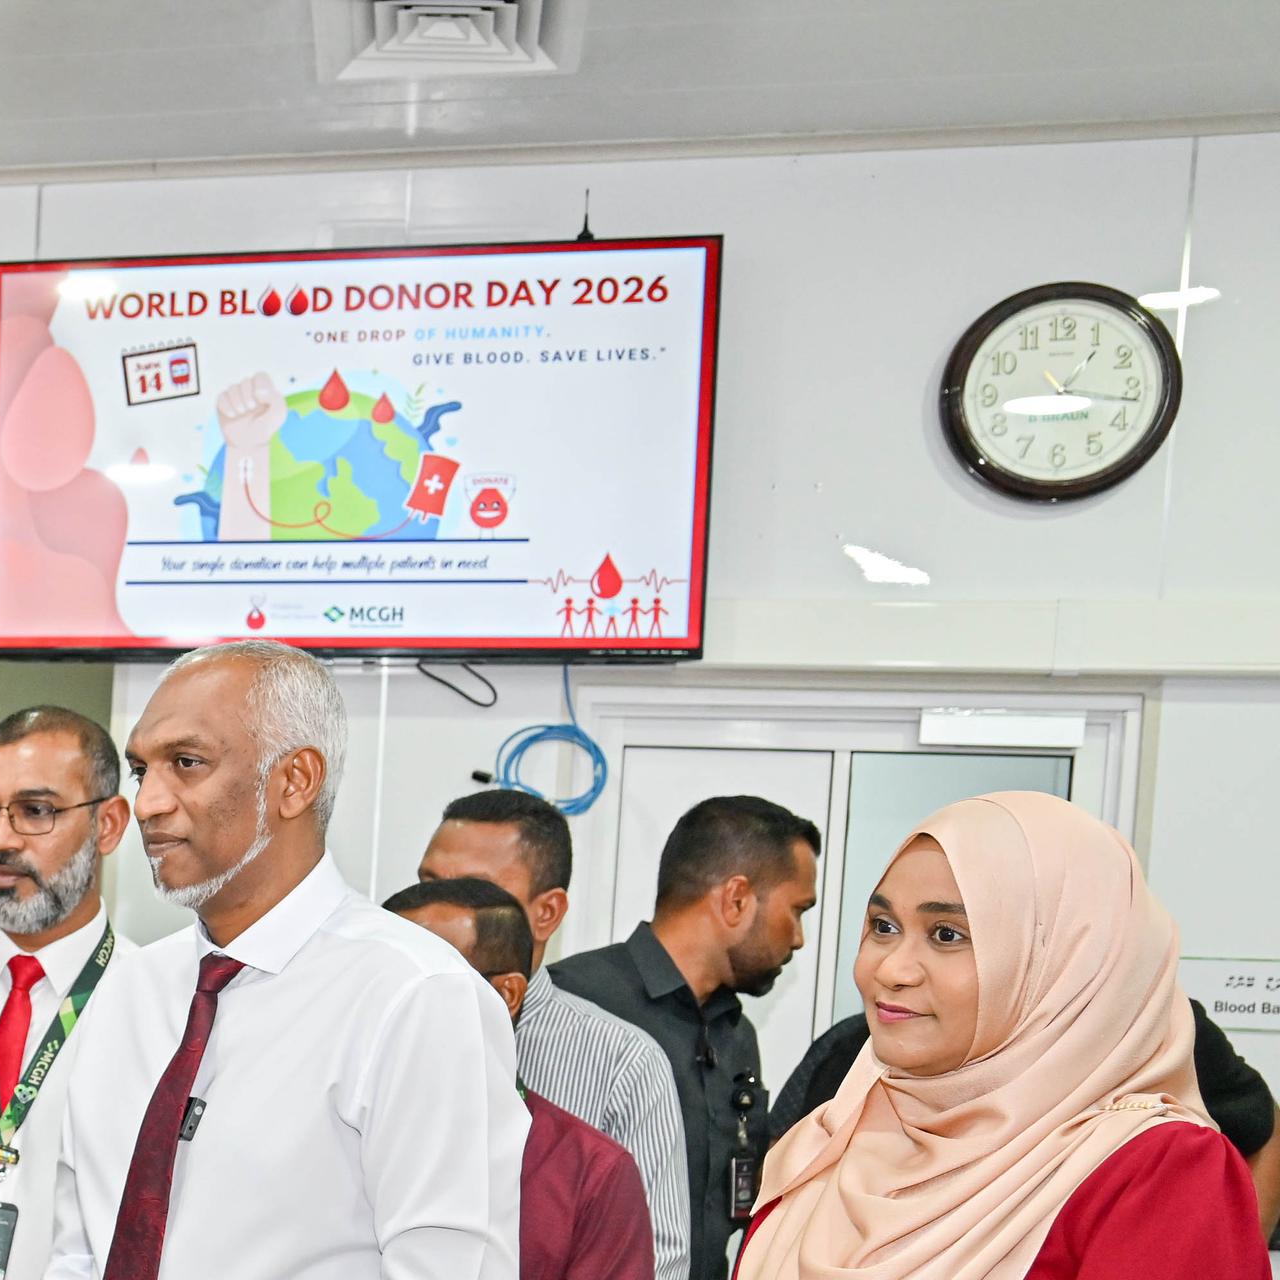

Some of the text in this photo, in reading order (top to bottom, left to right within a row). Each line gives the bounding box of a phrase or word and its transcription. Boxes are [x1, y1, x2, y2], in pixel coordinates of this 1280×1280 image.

[85, 290, 208, 320] WORLD
[344, 281, 474, 312] DONOR
[486, 278, 561, 308] DAY
[572, 275, 669, 305] 2026
[357, 329, 407, 343] DROP
[414, 328, 437, 342] OF
[1018, 326, 1039, 351] 11
[1049, 316, 1077, 342] 12
[412, 353, 455, 367] GIVE
[540, 349, 588, 363] SAVE
[991, 351, 1018, 376] 10
[1113, 344, 1133, 370] 2
[981, 383, 999, 408] 9
[991, 413, 1008, 437] 8
[1109, 406, 1129, 432] 4
[1016, 434, 1036, 459] 7
[1048, 443, 1066, 468] 6
[1086, 431, 1104, 456] 5
[161, 556, 186, 570] Your
[192, 556, 225, 576] single
[230, 556, 281, 570] donation
[286, 559, 308, 570] can
[312, 554, 337, 575] help
[457, 555, 489, 569] need
[349, 606, 405, 622] MCGH
[1214, 1000, 1256, 1014] Blood
[28, 1050, 55, 1086] MCGH
